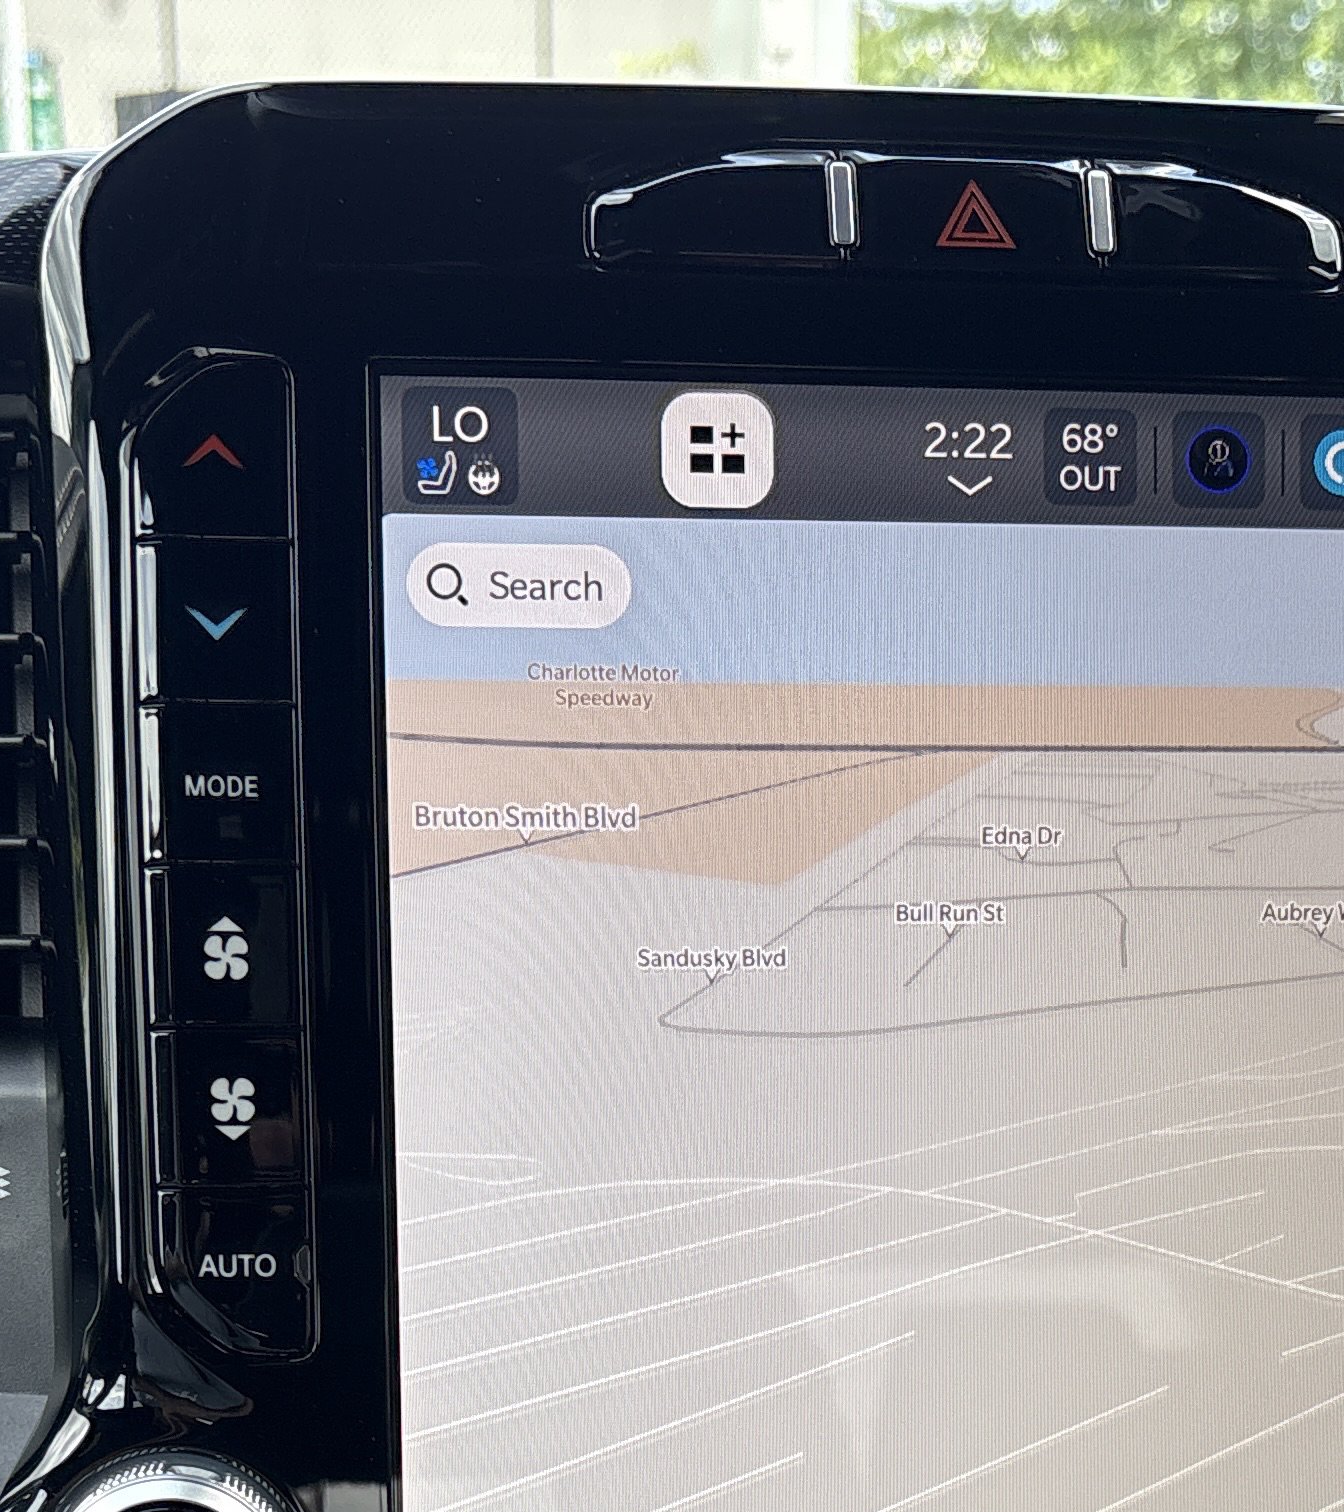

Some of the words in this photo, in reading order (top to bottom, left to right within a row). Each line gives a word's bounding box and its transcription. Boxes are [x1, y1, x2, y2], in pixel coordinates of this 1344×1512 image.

[431, 405, 489, 443] LO
[923, 421, 1014, 459] 2:22
[1061, 423, 1119, 454] 68°
[1059, 465, 1122, 492] OUT
[489, 571, 603, 602] Search
[527, 662, 617, 683] Charlotte
[620, 664, 680, 683] Motor
[555, 688, 653, 710] Speedway
[184, 774, 260, 798] MODE
[414, 804, 500, 829] Bruton
[505, 805, 577, 829] Smith
[584, 805, 637, 829] Blvd
[982, 826, 1033, 846] Edna
[1038, 826, 1061, 846] Dr
[896, 904, 934, 924] Bull
[939, 904, 975, 924] Run
[980, 904, 1004, 924] St
[1262, 902, 1332, 928] Aubrey
[637, 949, 737, 971] Sandusky
[742, 949, 787, 968] Blvd
[198, 1254, 277, 1278] AUTO
